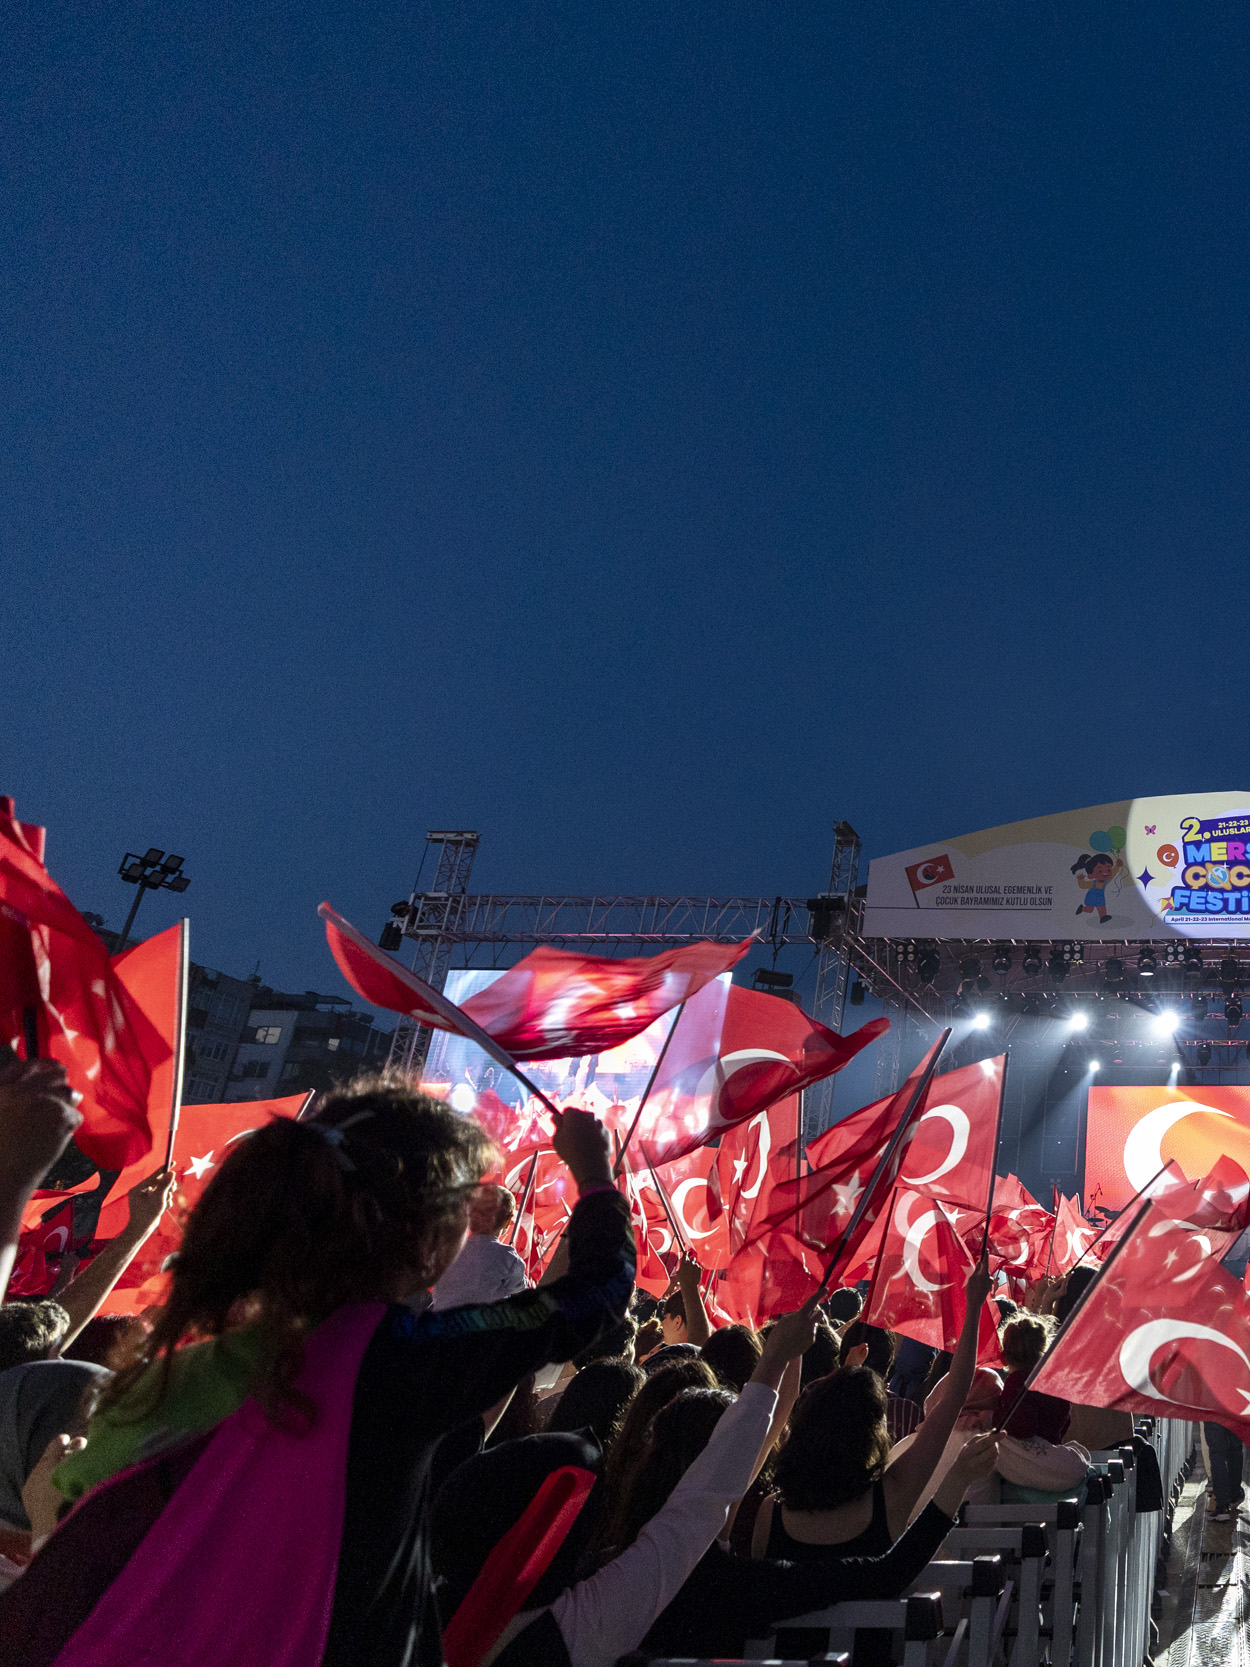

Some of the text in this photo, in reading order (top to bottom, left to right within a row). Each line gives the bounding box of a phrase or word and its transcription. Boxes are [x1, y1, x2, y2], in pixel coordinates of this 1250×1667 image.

[1218, 820, 1249, 828] 21-22-23
[1182, 819, 1211, 842] 2.
[942, 884, 1053, 895] 23 NİSAN ULUSAL EGEMENLİK VE
[935, 896, 1053, 907] ÇOCUK BAYRAMIMIZ KUTLU OLSUN
